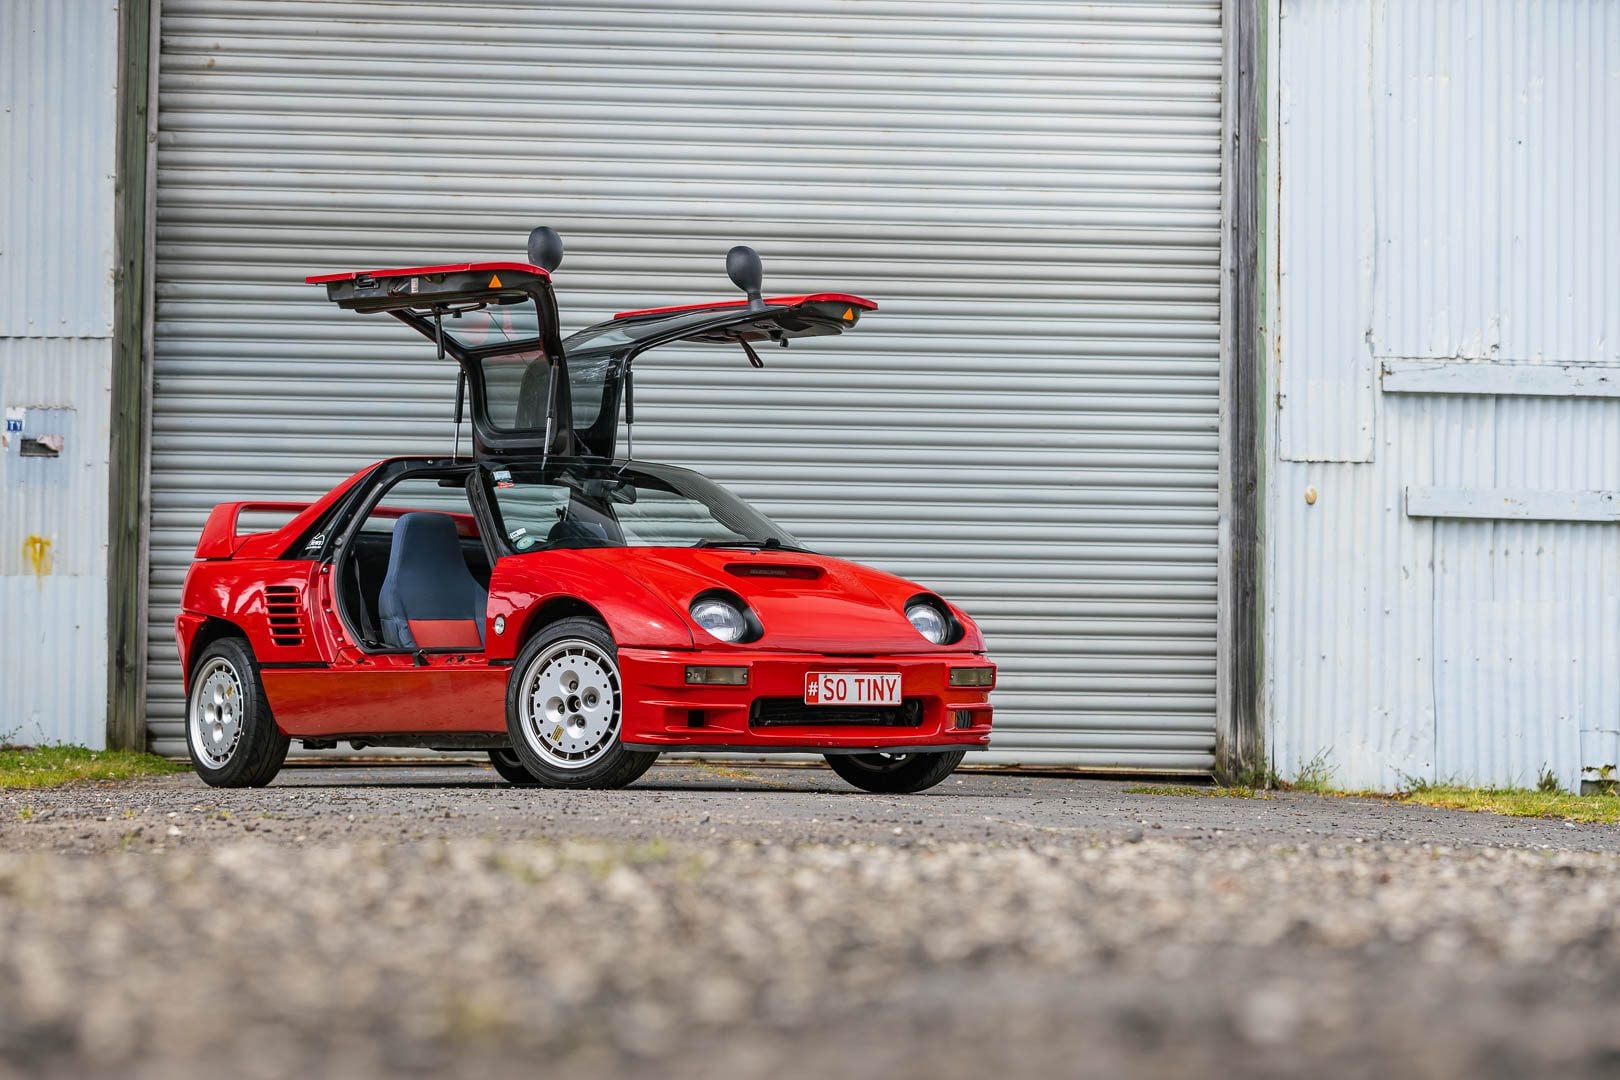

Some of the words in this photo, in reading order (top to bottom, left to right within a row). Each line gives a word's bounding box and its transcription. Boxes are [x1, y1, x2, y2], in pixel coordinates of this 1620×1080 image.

[807, 681, 818, 696] #
[823, 678, 847, 701] SO
[854, 678, 897, 701] TINY
